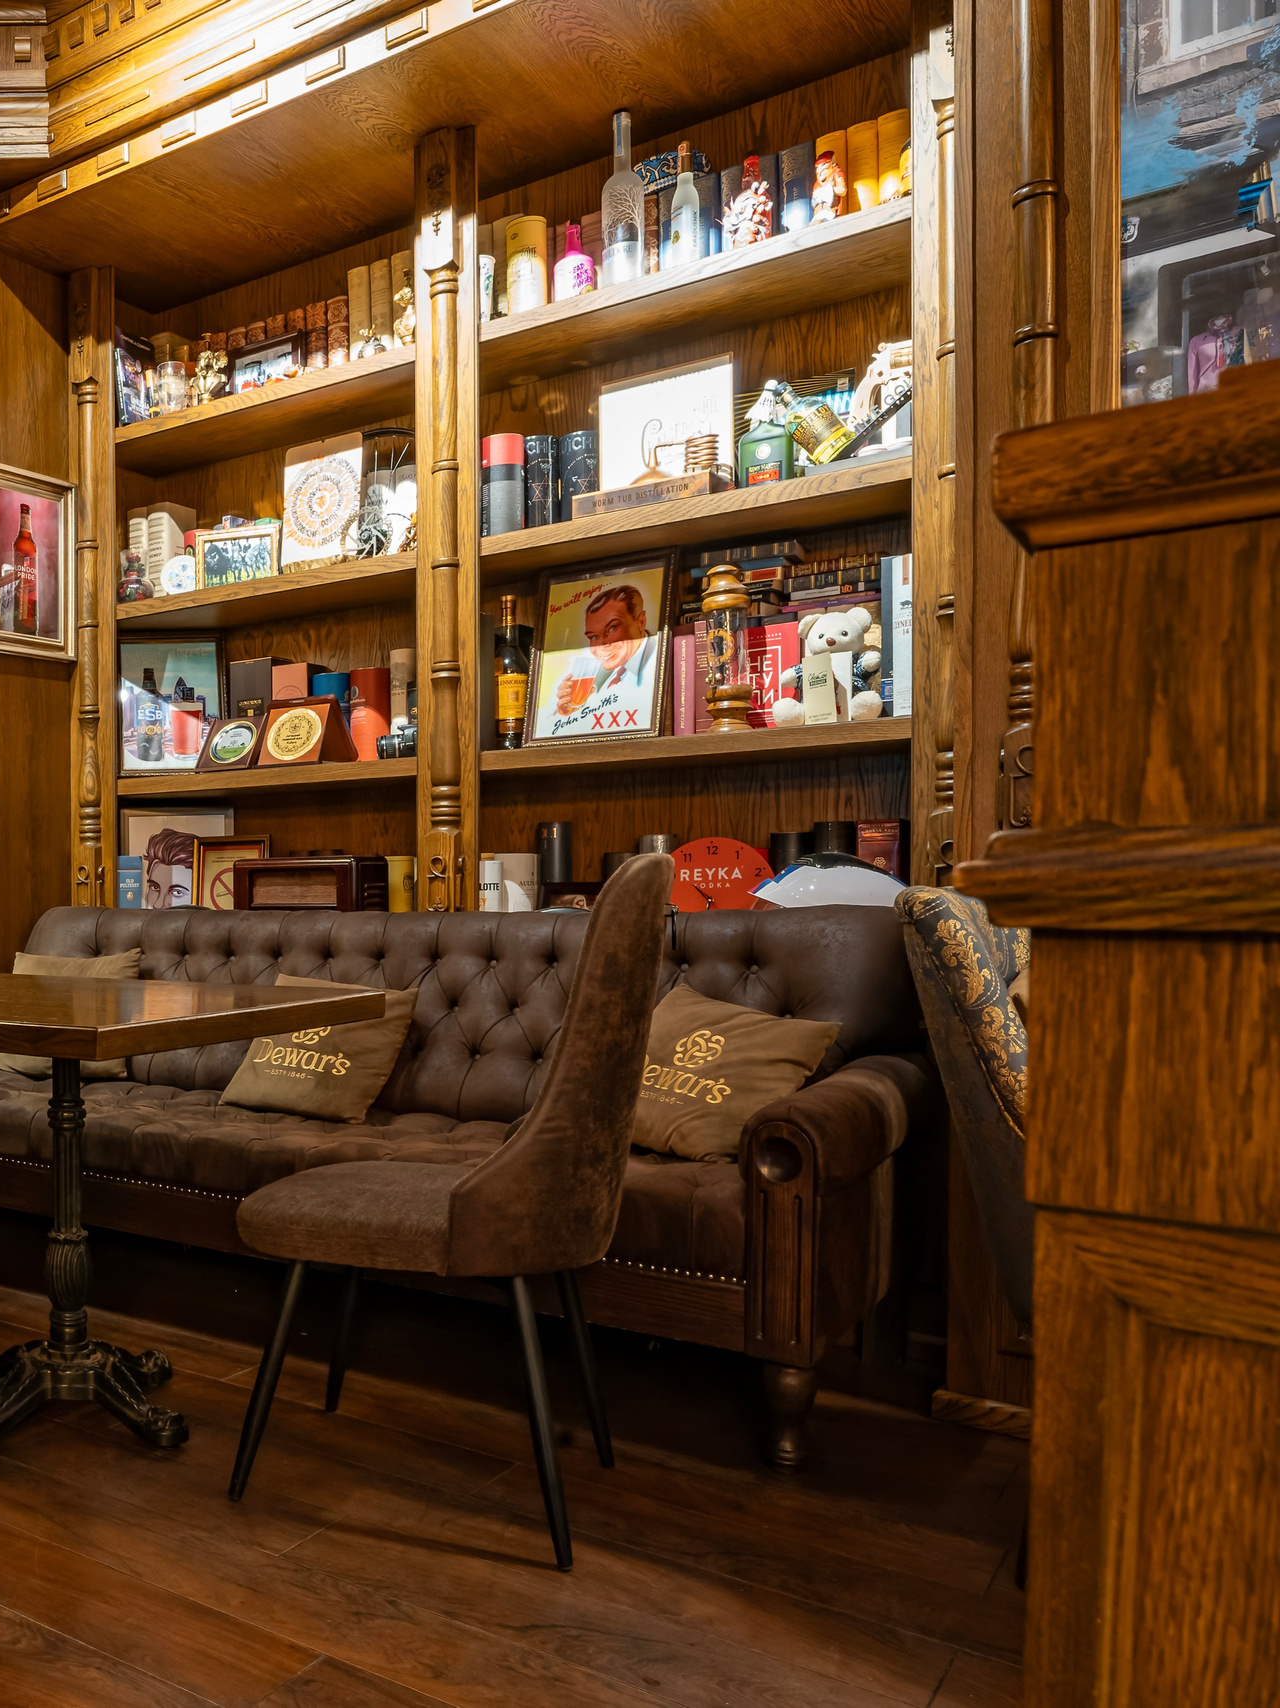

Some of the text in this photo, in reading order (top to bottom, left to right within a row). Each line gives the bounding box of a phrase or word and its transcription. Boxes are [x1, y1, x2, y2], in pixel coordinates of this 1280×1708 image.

[792, 405, 829, 440] ABERFELDY
[592, 483, 689, 508] WORM TUB DISTILLATION
[18, 572, 35, 580] PRIDE
[550, 604, 562, 616] You
[564, 592, 582, 608] will
[138, 708, 163, 720] ESB
[552, 694, 618, 735] John Smith's
[590, 709, 638, 730] XXX
[682, 846, 762, 877] 11 12 1 2
[680, 866, 742, 882] REYKA
[253, 1038, 351, 1076] Dewar's
[287, 1070, 306, 1079] 1846
